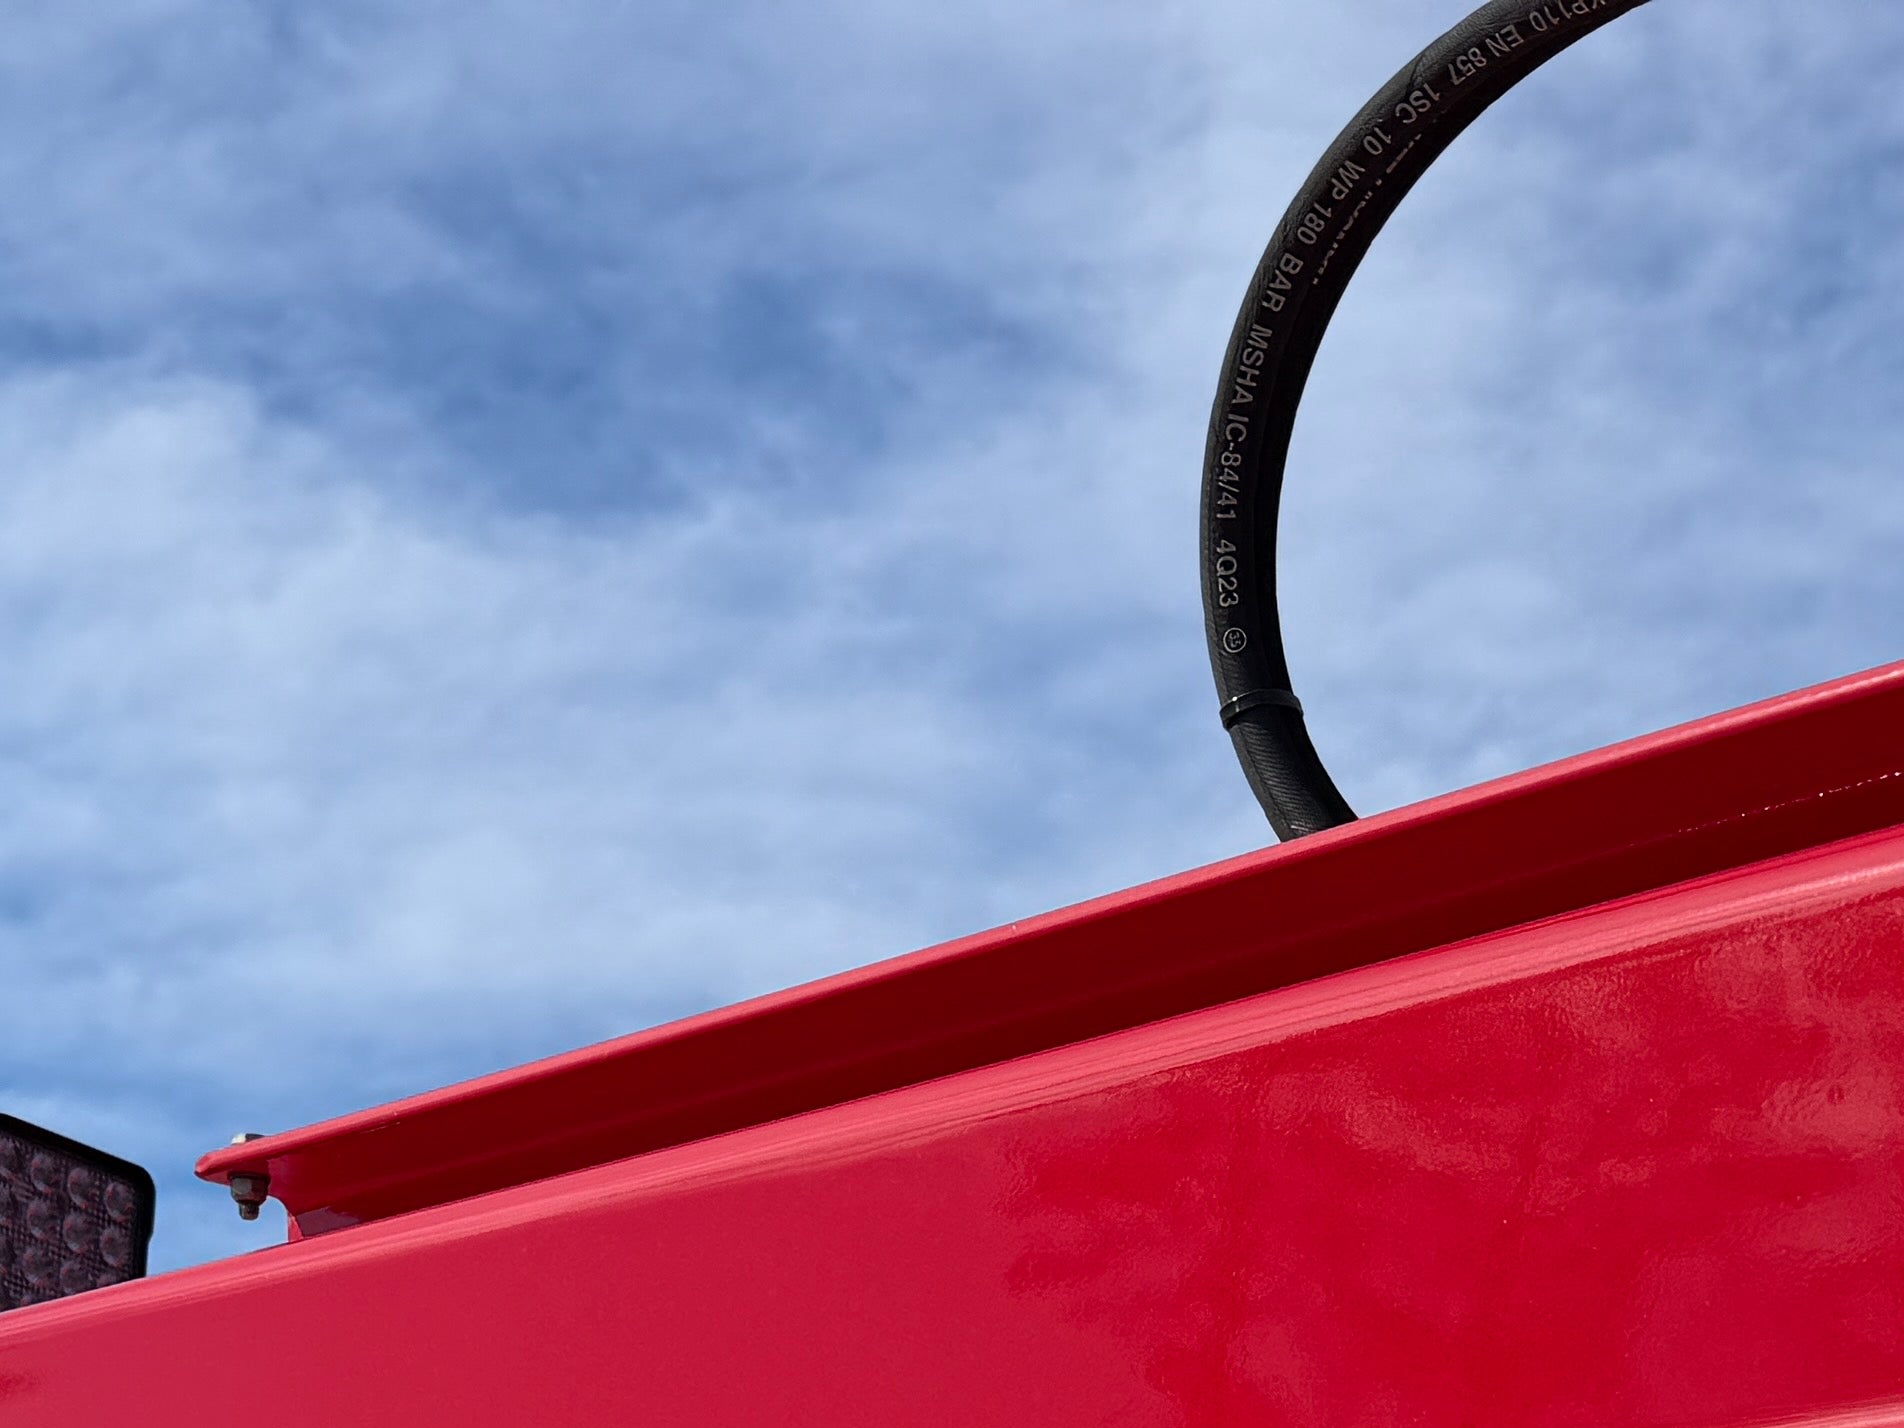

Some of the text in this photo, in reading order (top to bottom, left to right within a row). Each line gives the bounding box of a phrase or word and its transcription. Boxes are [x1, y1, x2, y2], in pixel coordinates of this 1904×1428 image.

[1485, 24, 1524, 57] EN
[1447, 46, 1488, 86] 857
[1395, 82, 1441, 124] 1SC
[1363, 126, 1392, 156] 10
[1331, 159, 1366, 201] WP
[1297, 202, 1332, 245] 180
[1261, 252, 1304, 312] BAR
[1231, 323, 1273, 404] MSHA
[1215, 413, 1249, 519] IC-84/41
[1216, 539, 1239, 607] 4Q23
